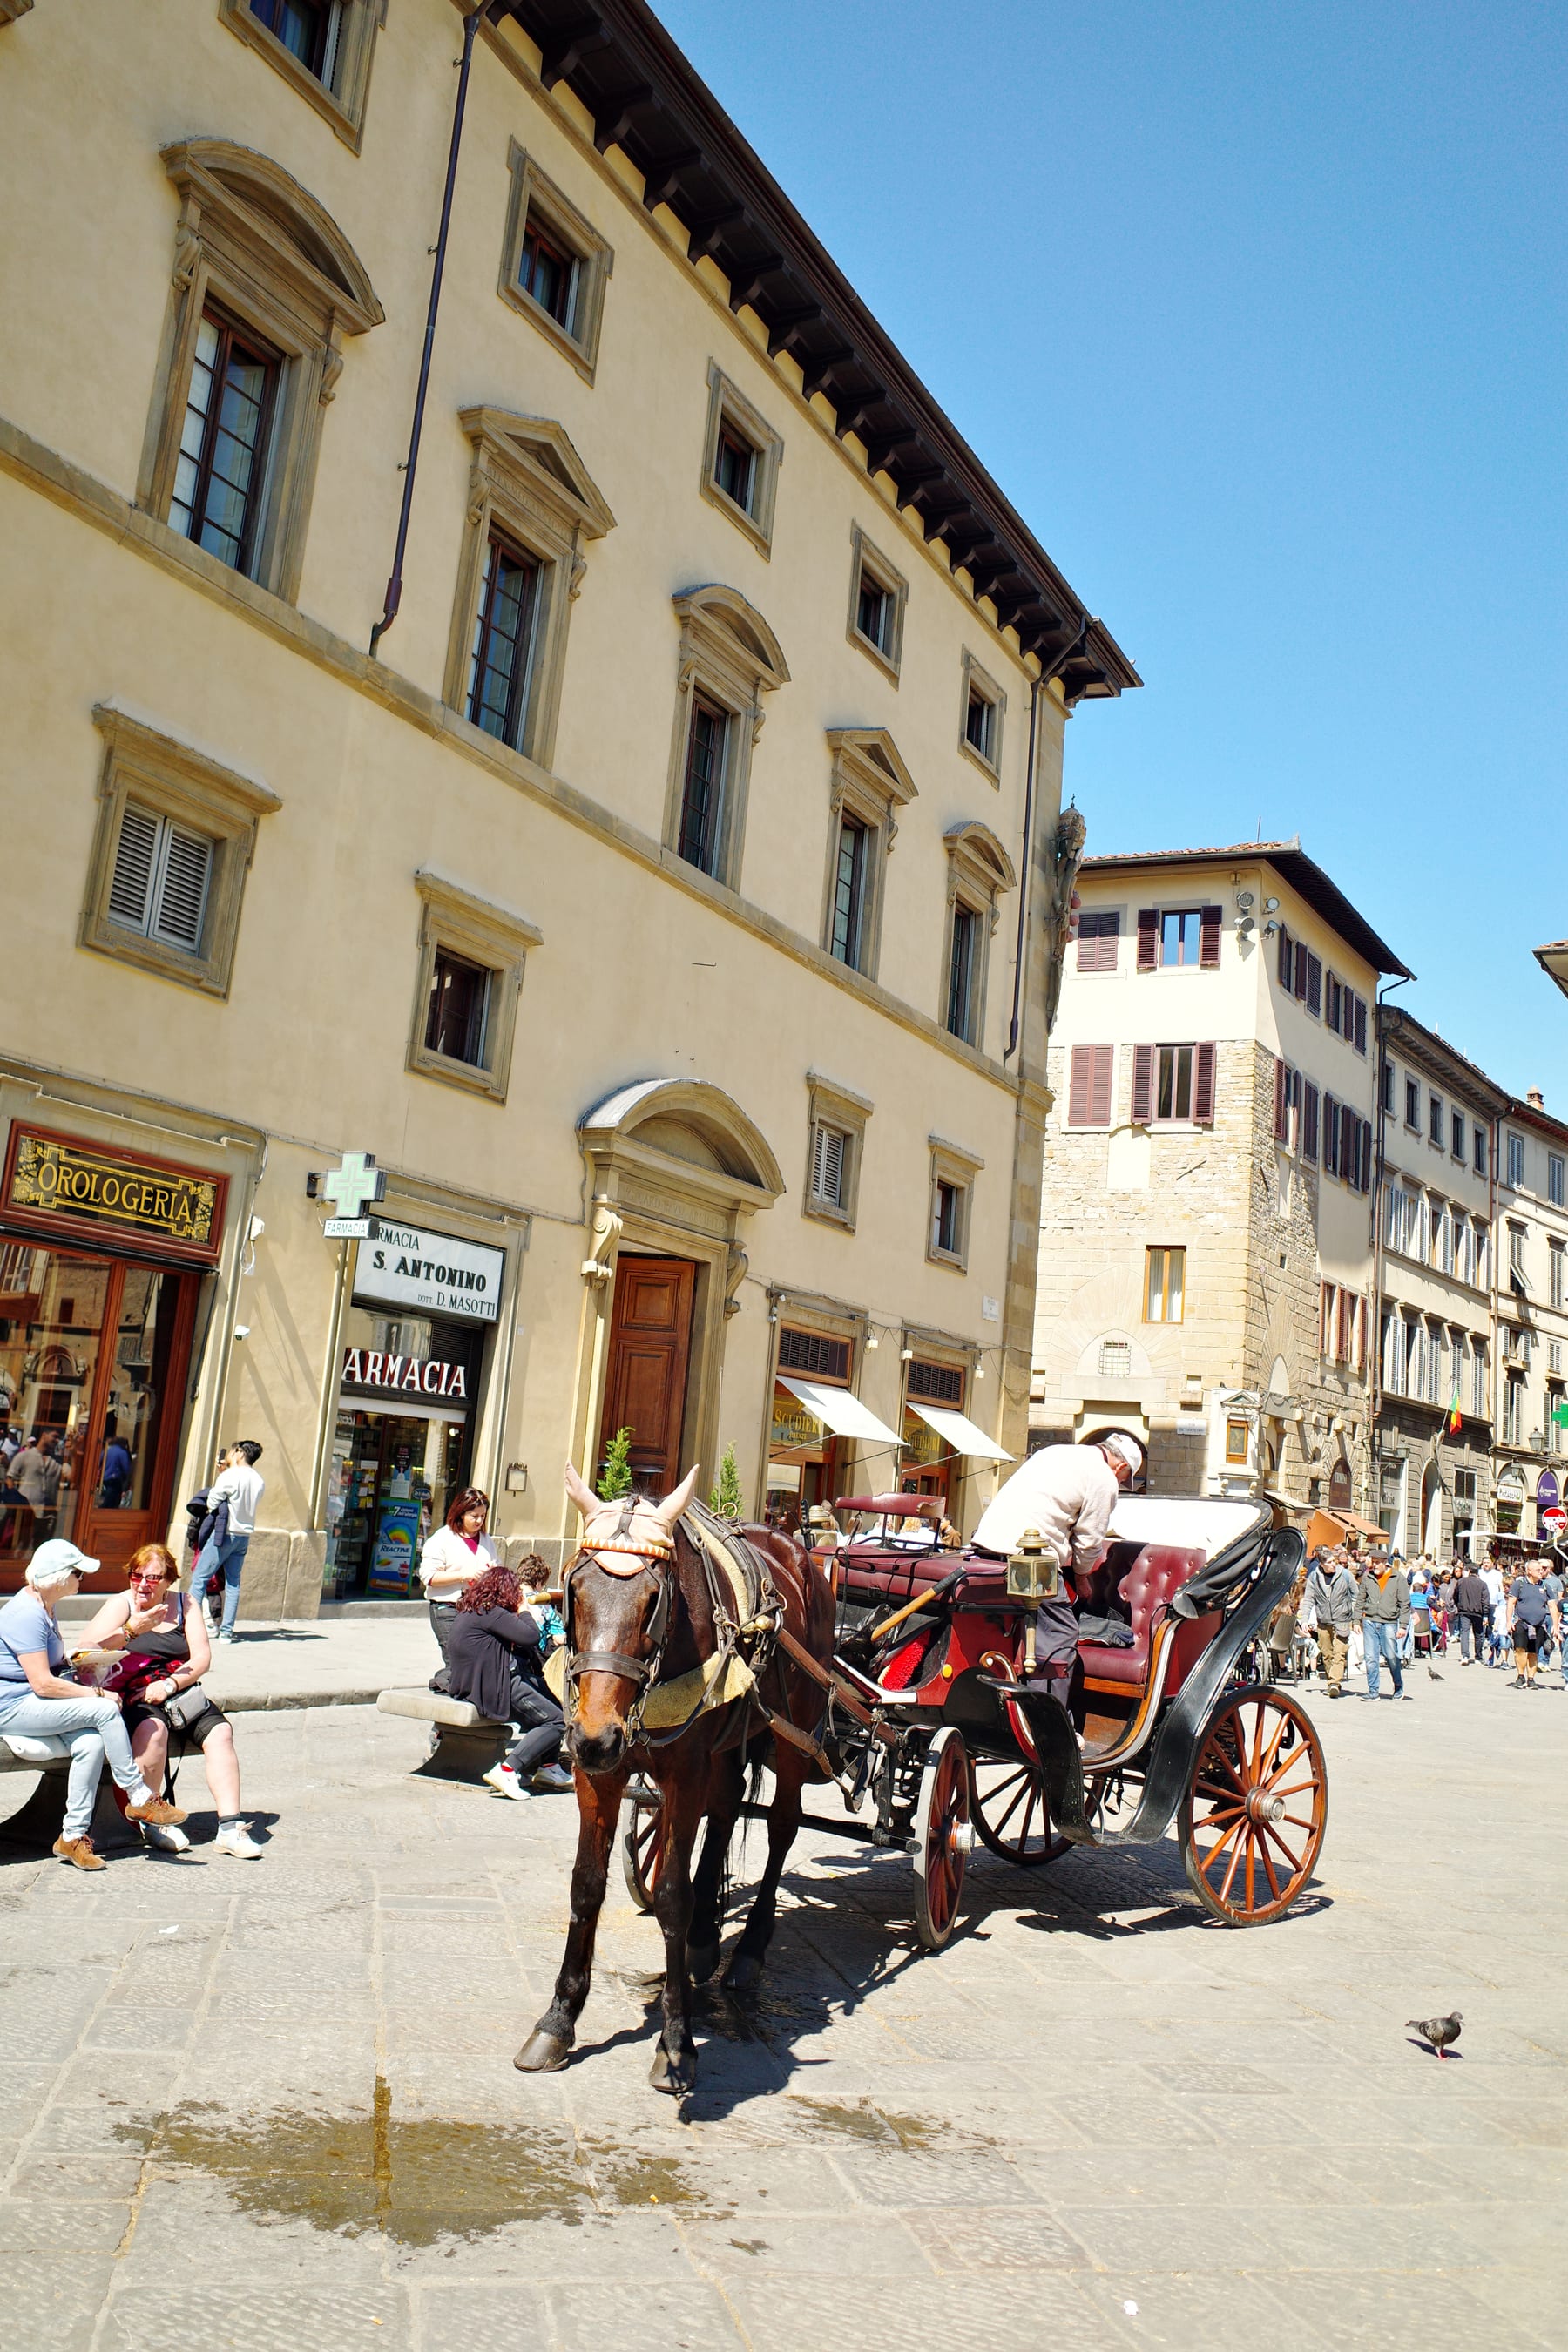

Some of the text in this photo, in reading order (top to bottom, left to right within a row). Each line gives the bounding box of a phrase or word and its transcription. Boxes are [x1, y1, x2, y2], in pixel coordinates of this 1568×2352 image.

[37, 1162, 193, 1224] OROLOGERIA
[326, 1222, 366, 1235] FARMACIA
[376, 1226, 420, 1251] RMACIA
[373, 1250, 487, 1293] S. ANTONINO
[417, 1291, 496, 1317] DOTT. D. MASOTTI
[341, 1348, 467, 1398] ARMACIA
[393, 1505, 402, 1517] 7
[379, 1544, 411, 1553] REACTINE
